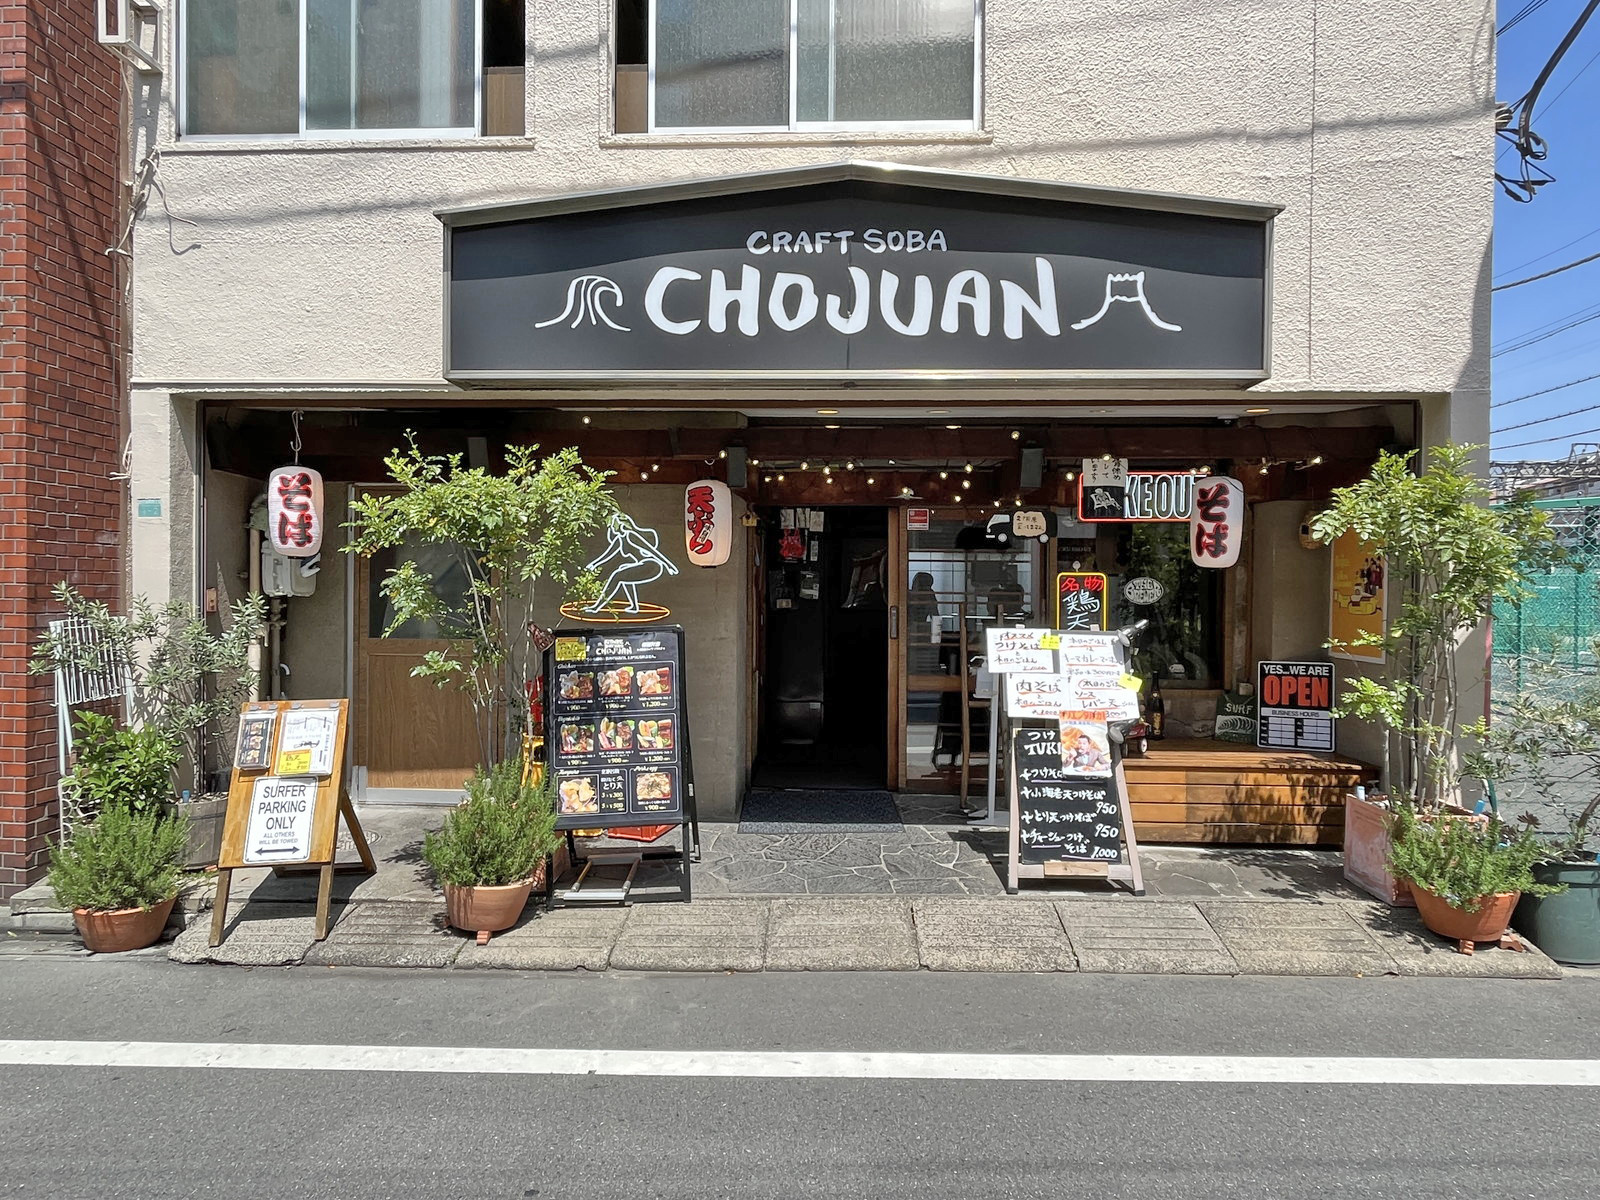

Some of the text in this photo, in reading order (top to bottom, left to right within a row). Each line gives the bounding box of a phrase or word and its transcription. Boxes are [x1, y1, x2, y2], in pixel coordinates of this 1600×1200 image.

[746, 228, 949, 255] CRAFT SOBA
[644, 257, 1061, 340] CHOJUAN
[278, 472, 313, 547] そば
[1195, 482, 1230, 558] そば
[1061, 576, 1104, 591] 名物
[1307, 666, 1330, 676] ARE
[1016, 679, 1061, 692] 肉そば
[1082, 680, 1122, 689] 本日のごは
[1263, 675, 1329, 707] OPEN
[1082, 698, 1119, 708] レバー天
[1225, 703, 1253, 715] SURF
[263, 785, 306, 798] SURFER
[603, 782, 623, 790] とり天
[1031, 786, 1106, 800] 小海老天つけそば
[258, 800, 306, 814] PARKING
[1095, 801, 1117, 814] 950
[266, 816, 296, 830] ONLY
[1034, 809, 1097, 823] とり天つけそば
[1094, 823, 1119, 838] 950
[1064, 838, 1090, 853] そば
